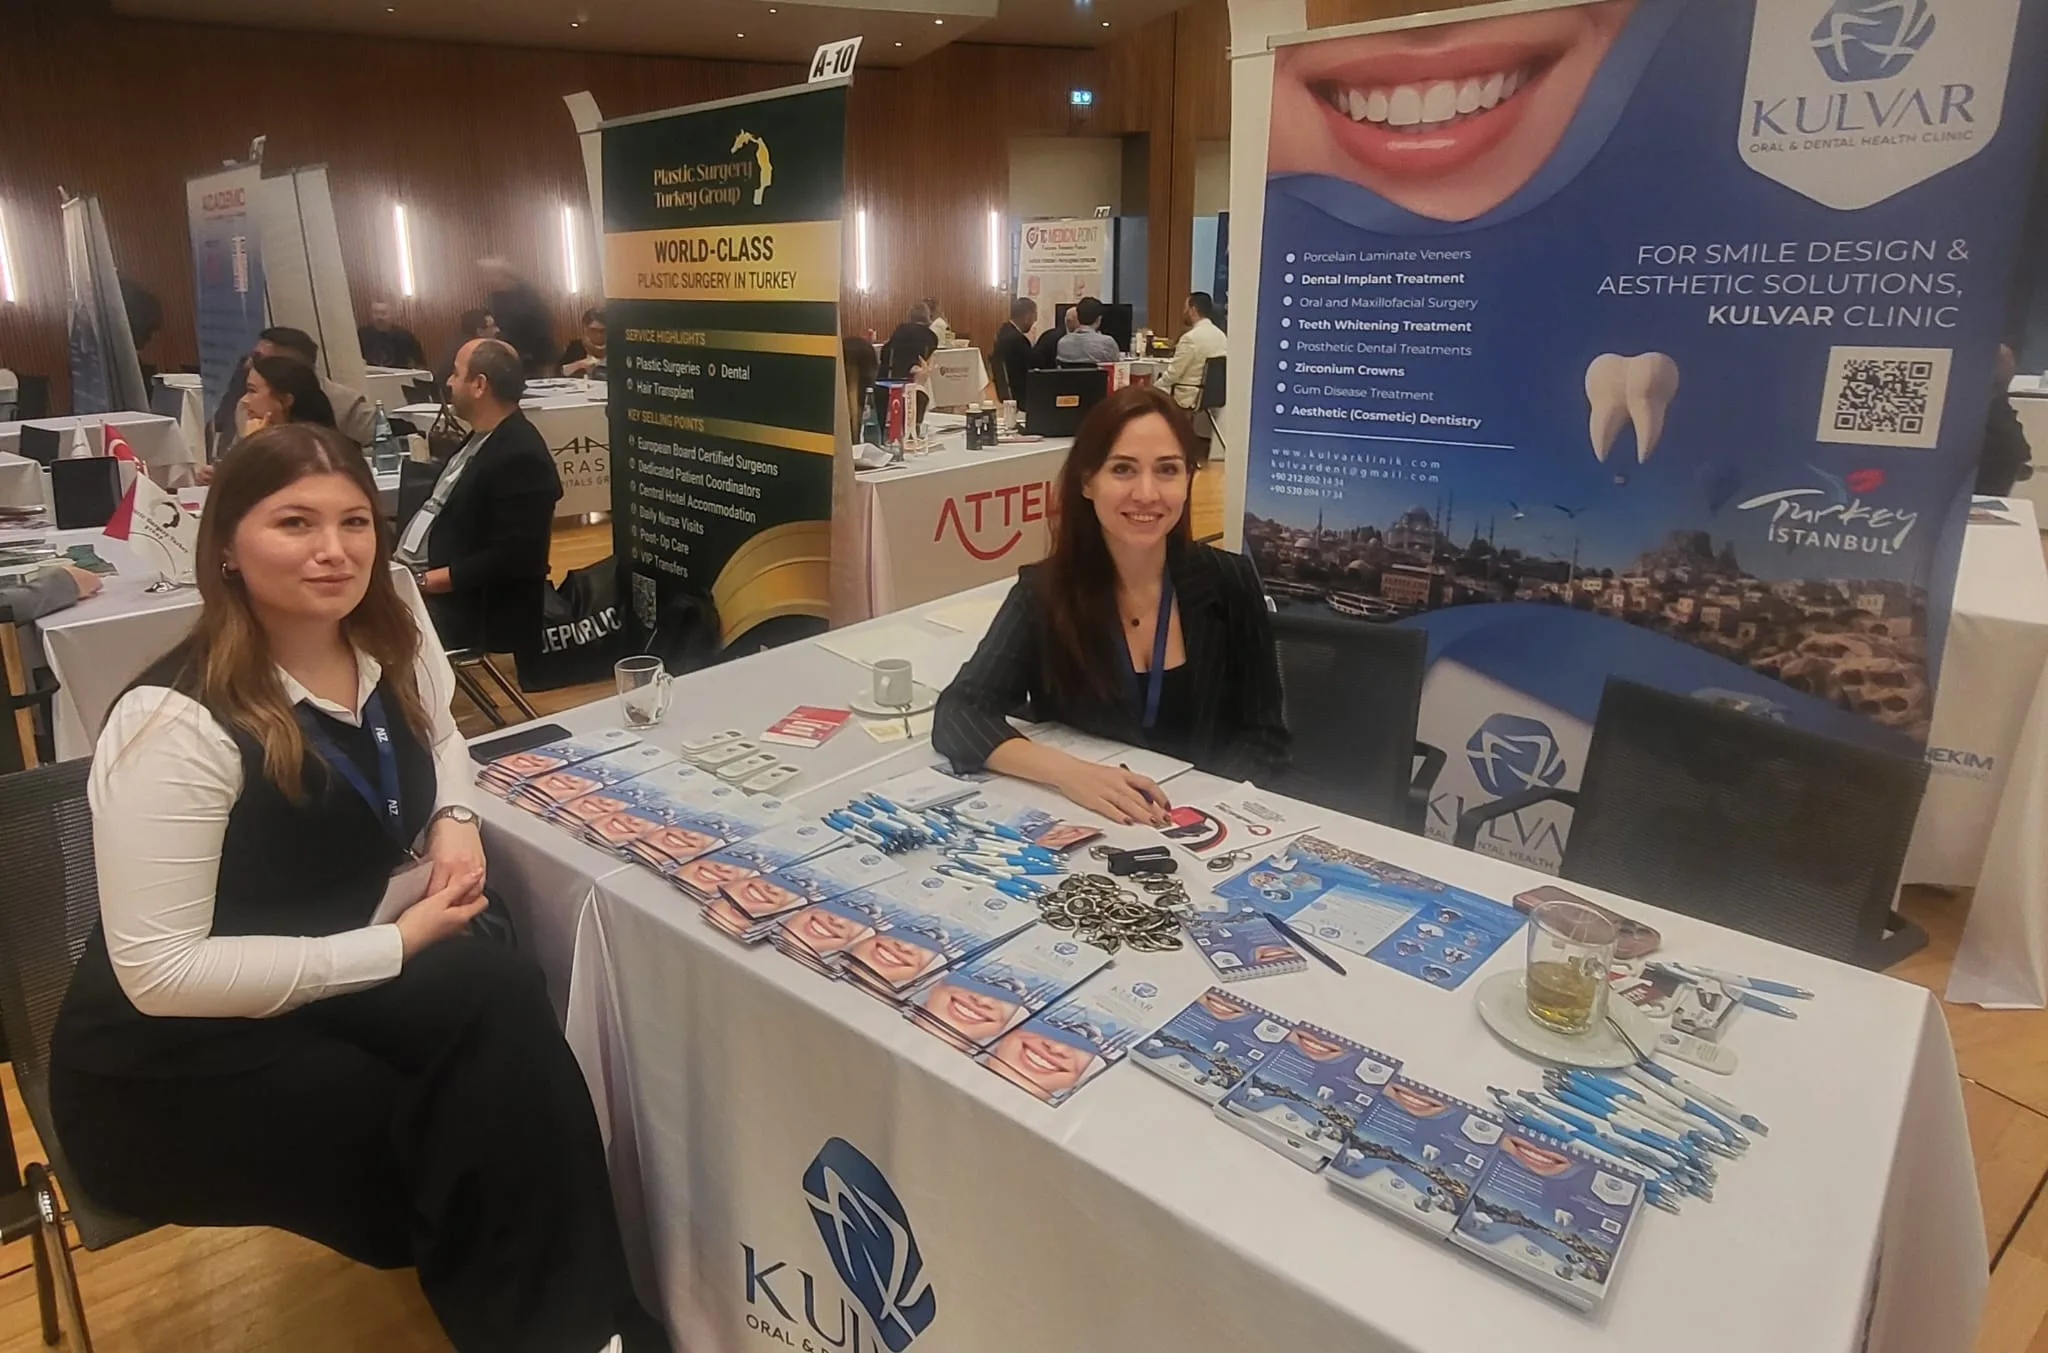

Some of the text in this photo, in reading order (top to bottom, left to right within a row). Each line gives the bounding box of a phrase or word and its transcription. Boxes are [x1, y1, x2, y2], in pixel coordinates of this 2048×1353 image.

[812, 43, 855, 78] A-10
[1752, 83, 1975, 137] KULVAR
[1750, 130, 1974, 153] ORAL & DENTAL HEALTH CLINIC
[653, 160, 753, 187] Plastic Surgery
[654, 186, 741, 211] Turkey Group
[655, 235, 774, 264] WORLD-CLASS
[1303, 248, 1472, 263] Porcelain Laminate Veneers
[1638, 238, 1970, 266] FOR SMILE DESIGN &
[638, 270, 797, 289] PLASTIC SURGERY IN TURKEY
[1302, 272, 1465, 287] Dental Implant Treatment
[1596, 271, 1964, 299] AESTHETIC SOLUTIONS,
[1300, 296, 1478, 311] Oral and Maxillofacial Surgery
[1298, 318, 1472, 333] Teeth Whitening Treatment
[1707, 304, 1960, 329] KULVAR CLINIC
[625, 328, 706, 346] SERVICE HIGHLIGHTS
[1297, 340, 1472, 357] Prosthetic Dental Treatments
[636, 356, 750, 381] Plastic Surgeries Dental
[1295, 362, 1405, 378] Zirconium Crowns
[636, 380, 694, 400] Hair Transplant
[1293, 384, 1434, 401] Gum Disease Treatment
[628, 408, 704, 432] KEY SELLING POINTS
[1291, 405, 1482, 430] Aesthetic (Cosmetic) Dentistry
[637, 436, 779, 477] European Board Certified Surgeons
[561, 478, 593, 489] ITALS
[638, 459, 761, 499] Dedicated Patient Coordinators
[639, 482, 756, 524] Central Hotel Accommodation
[639, 505, 704, 535] Daily Nurse Visits
[1737, 488, 1918, 550] Turkey
[659, 535, 670, 550] Op
[671, 537, 689, 555] Care
[640, 550, 689, 578] VIP Transfers
[1509, 847, 1554, 869] HEALTH
[745, 1313, 795, 1347] ORAL
